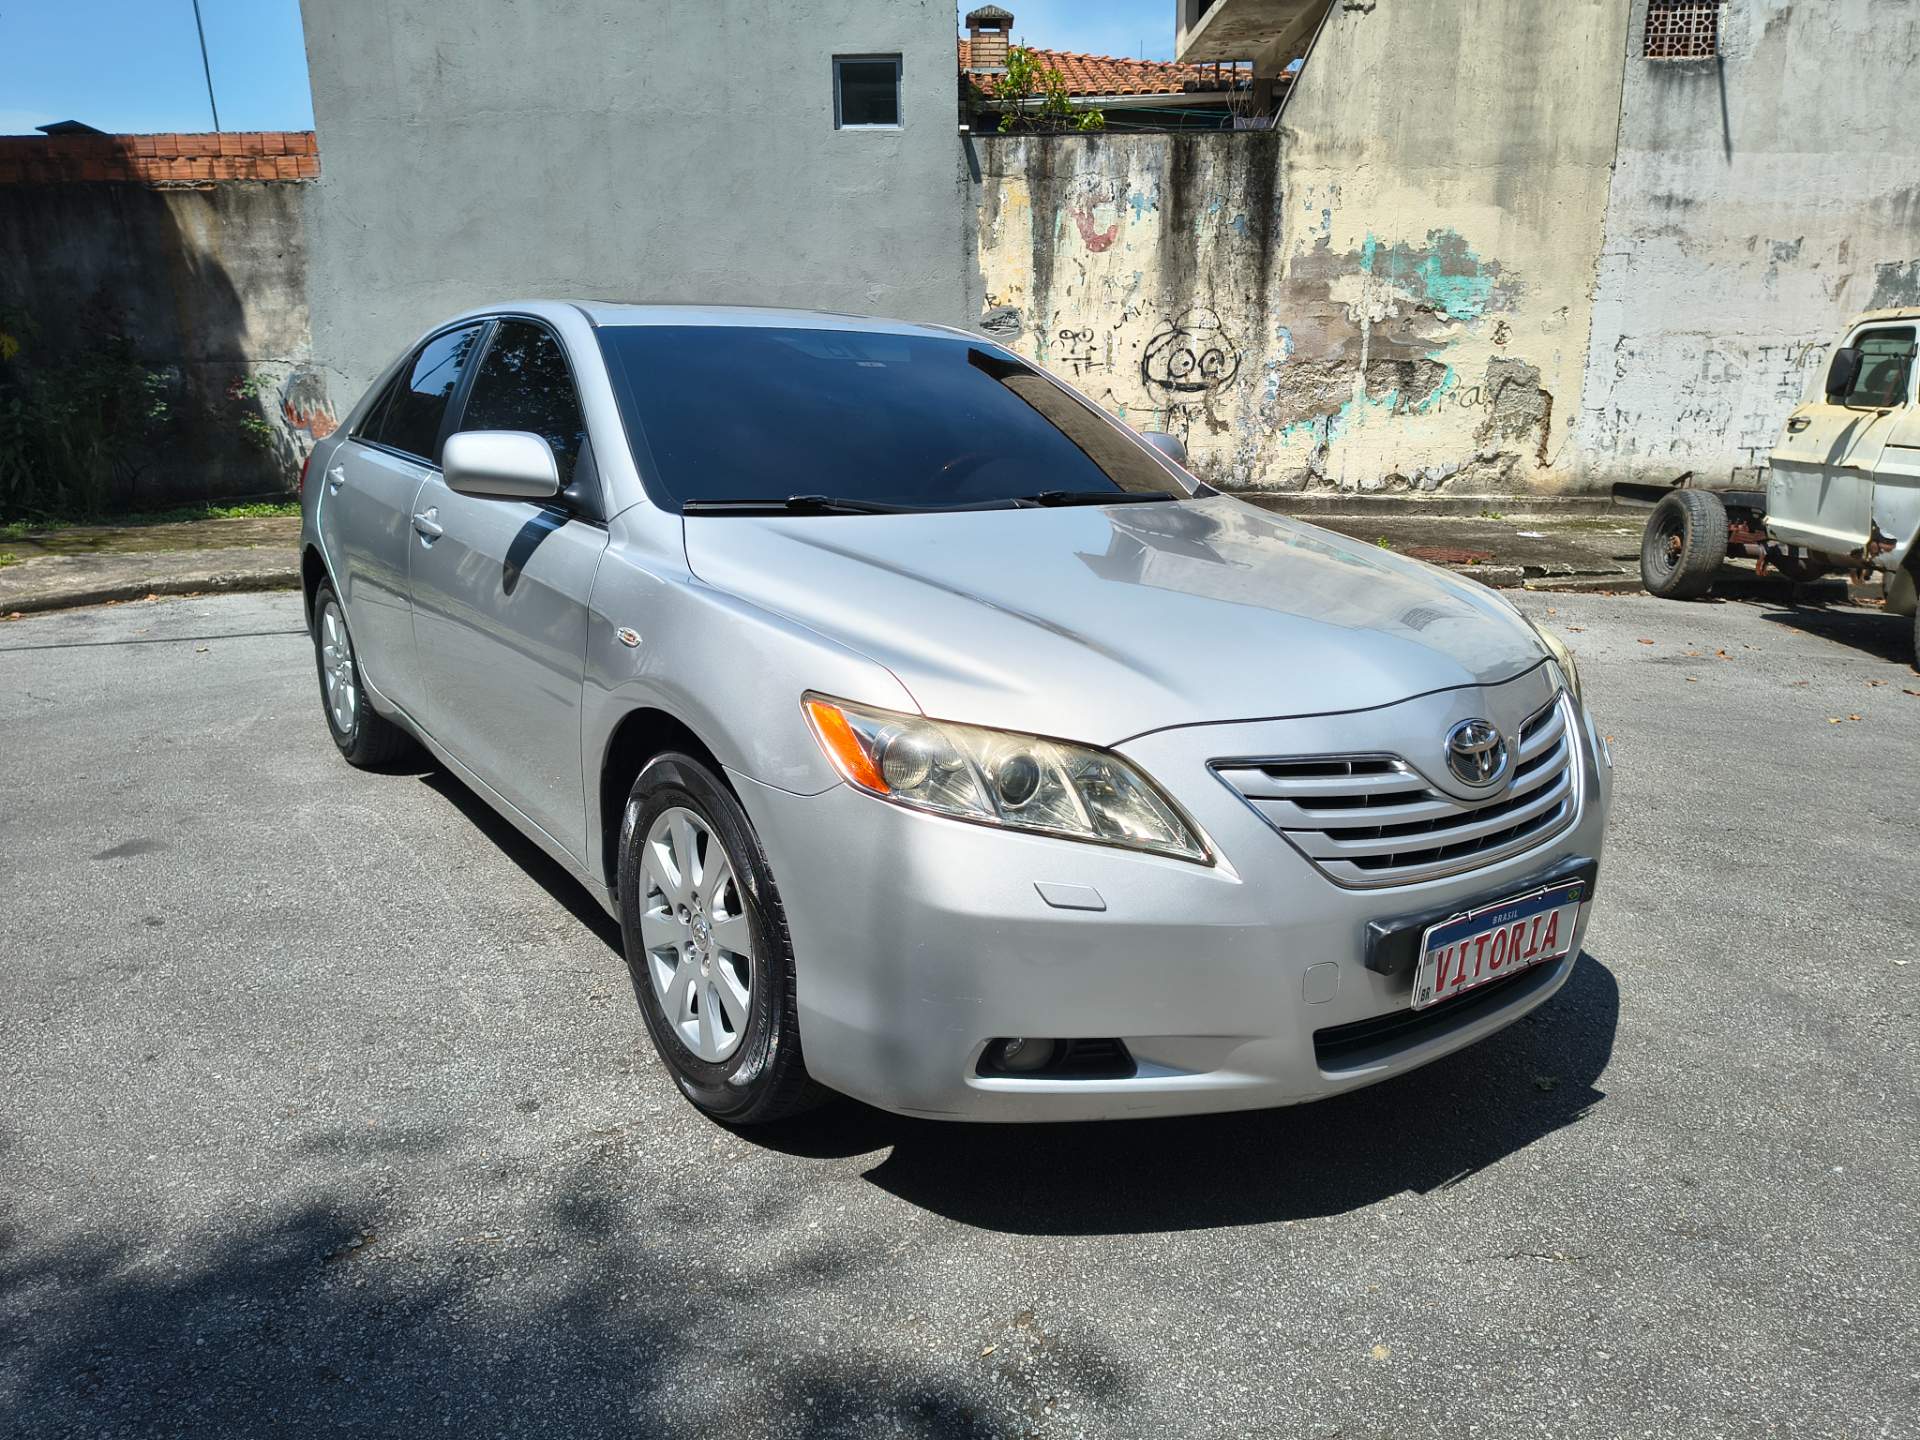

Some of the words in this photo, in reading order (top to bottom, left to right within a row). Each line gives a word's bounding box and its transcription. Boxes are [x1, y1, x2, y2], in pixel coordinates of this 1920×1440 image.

[1492, 910, 1518, 925] BRASIL
[1434, 910, 1559, 992] VITORIA
[1420, 986, 1431, 1001] BR
